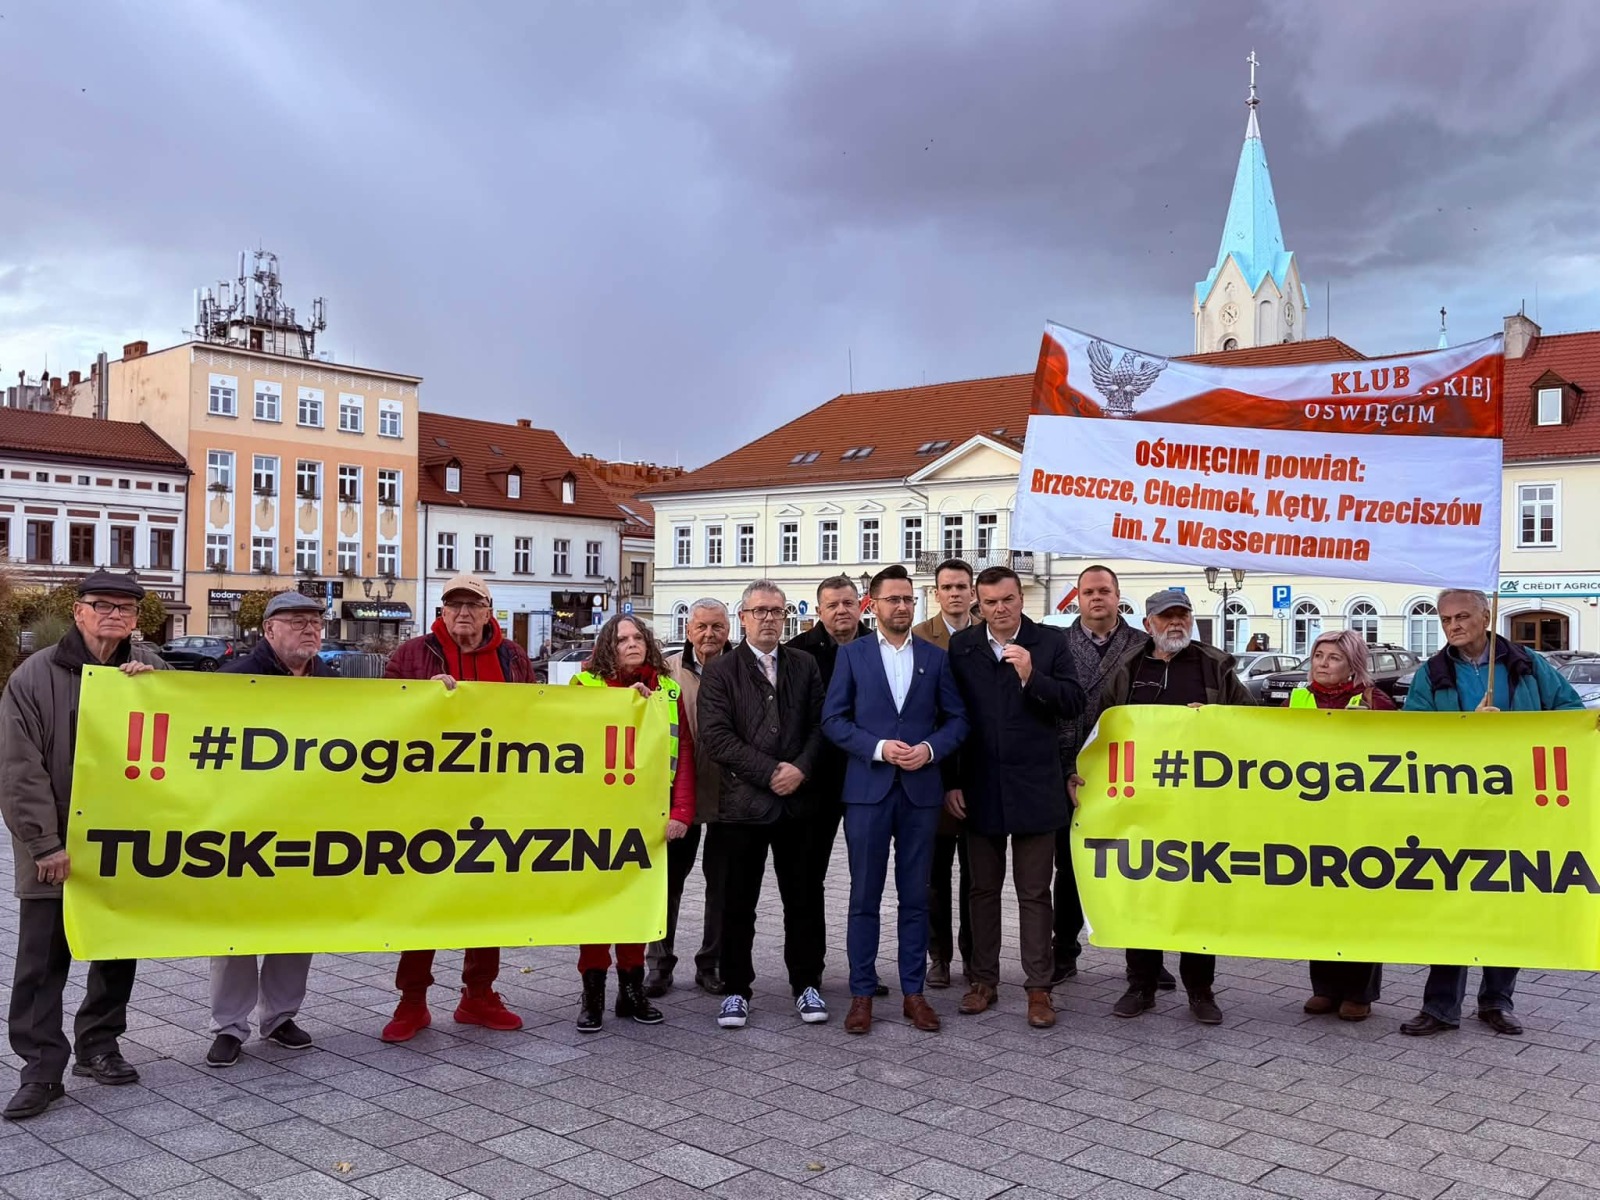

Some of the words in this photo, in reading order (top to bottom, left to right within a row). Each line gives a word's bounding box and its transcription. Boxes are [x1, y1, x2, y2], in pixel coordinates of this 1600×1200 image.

[1331, 366, 1410, 395] KLUB
[1136, 438, 1260, 476] OŚWIĘCIM
[1265, 454, 1366, 482] powiat:
[1031, 469, 1138, 505] Brzeszcze,
[1144, 479, 1260, 517] Chełmek,
[1266, 490, 1330, 522] Kęty,
[1337, 495, 1482, 525] Przeciszów
[1112, 513, 1148, 541] im.
[1152, 518, 1171, 544] Z.
[1178, 520, 1370, 561] Wassermanna
[1277, 587, 1287, 601] P
[190, 727, 583, 783] #DrogaZima
[1153, 750, 1513, 801] #DrogaZima
[87, 817, 651, 879] TUSK=DROŻYZNA
[1085, 836, 1600, 894] TUSK=DROŻYZNA
